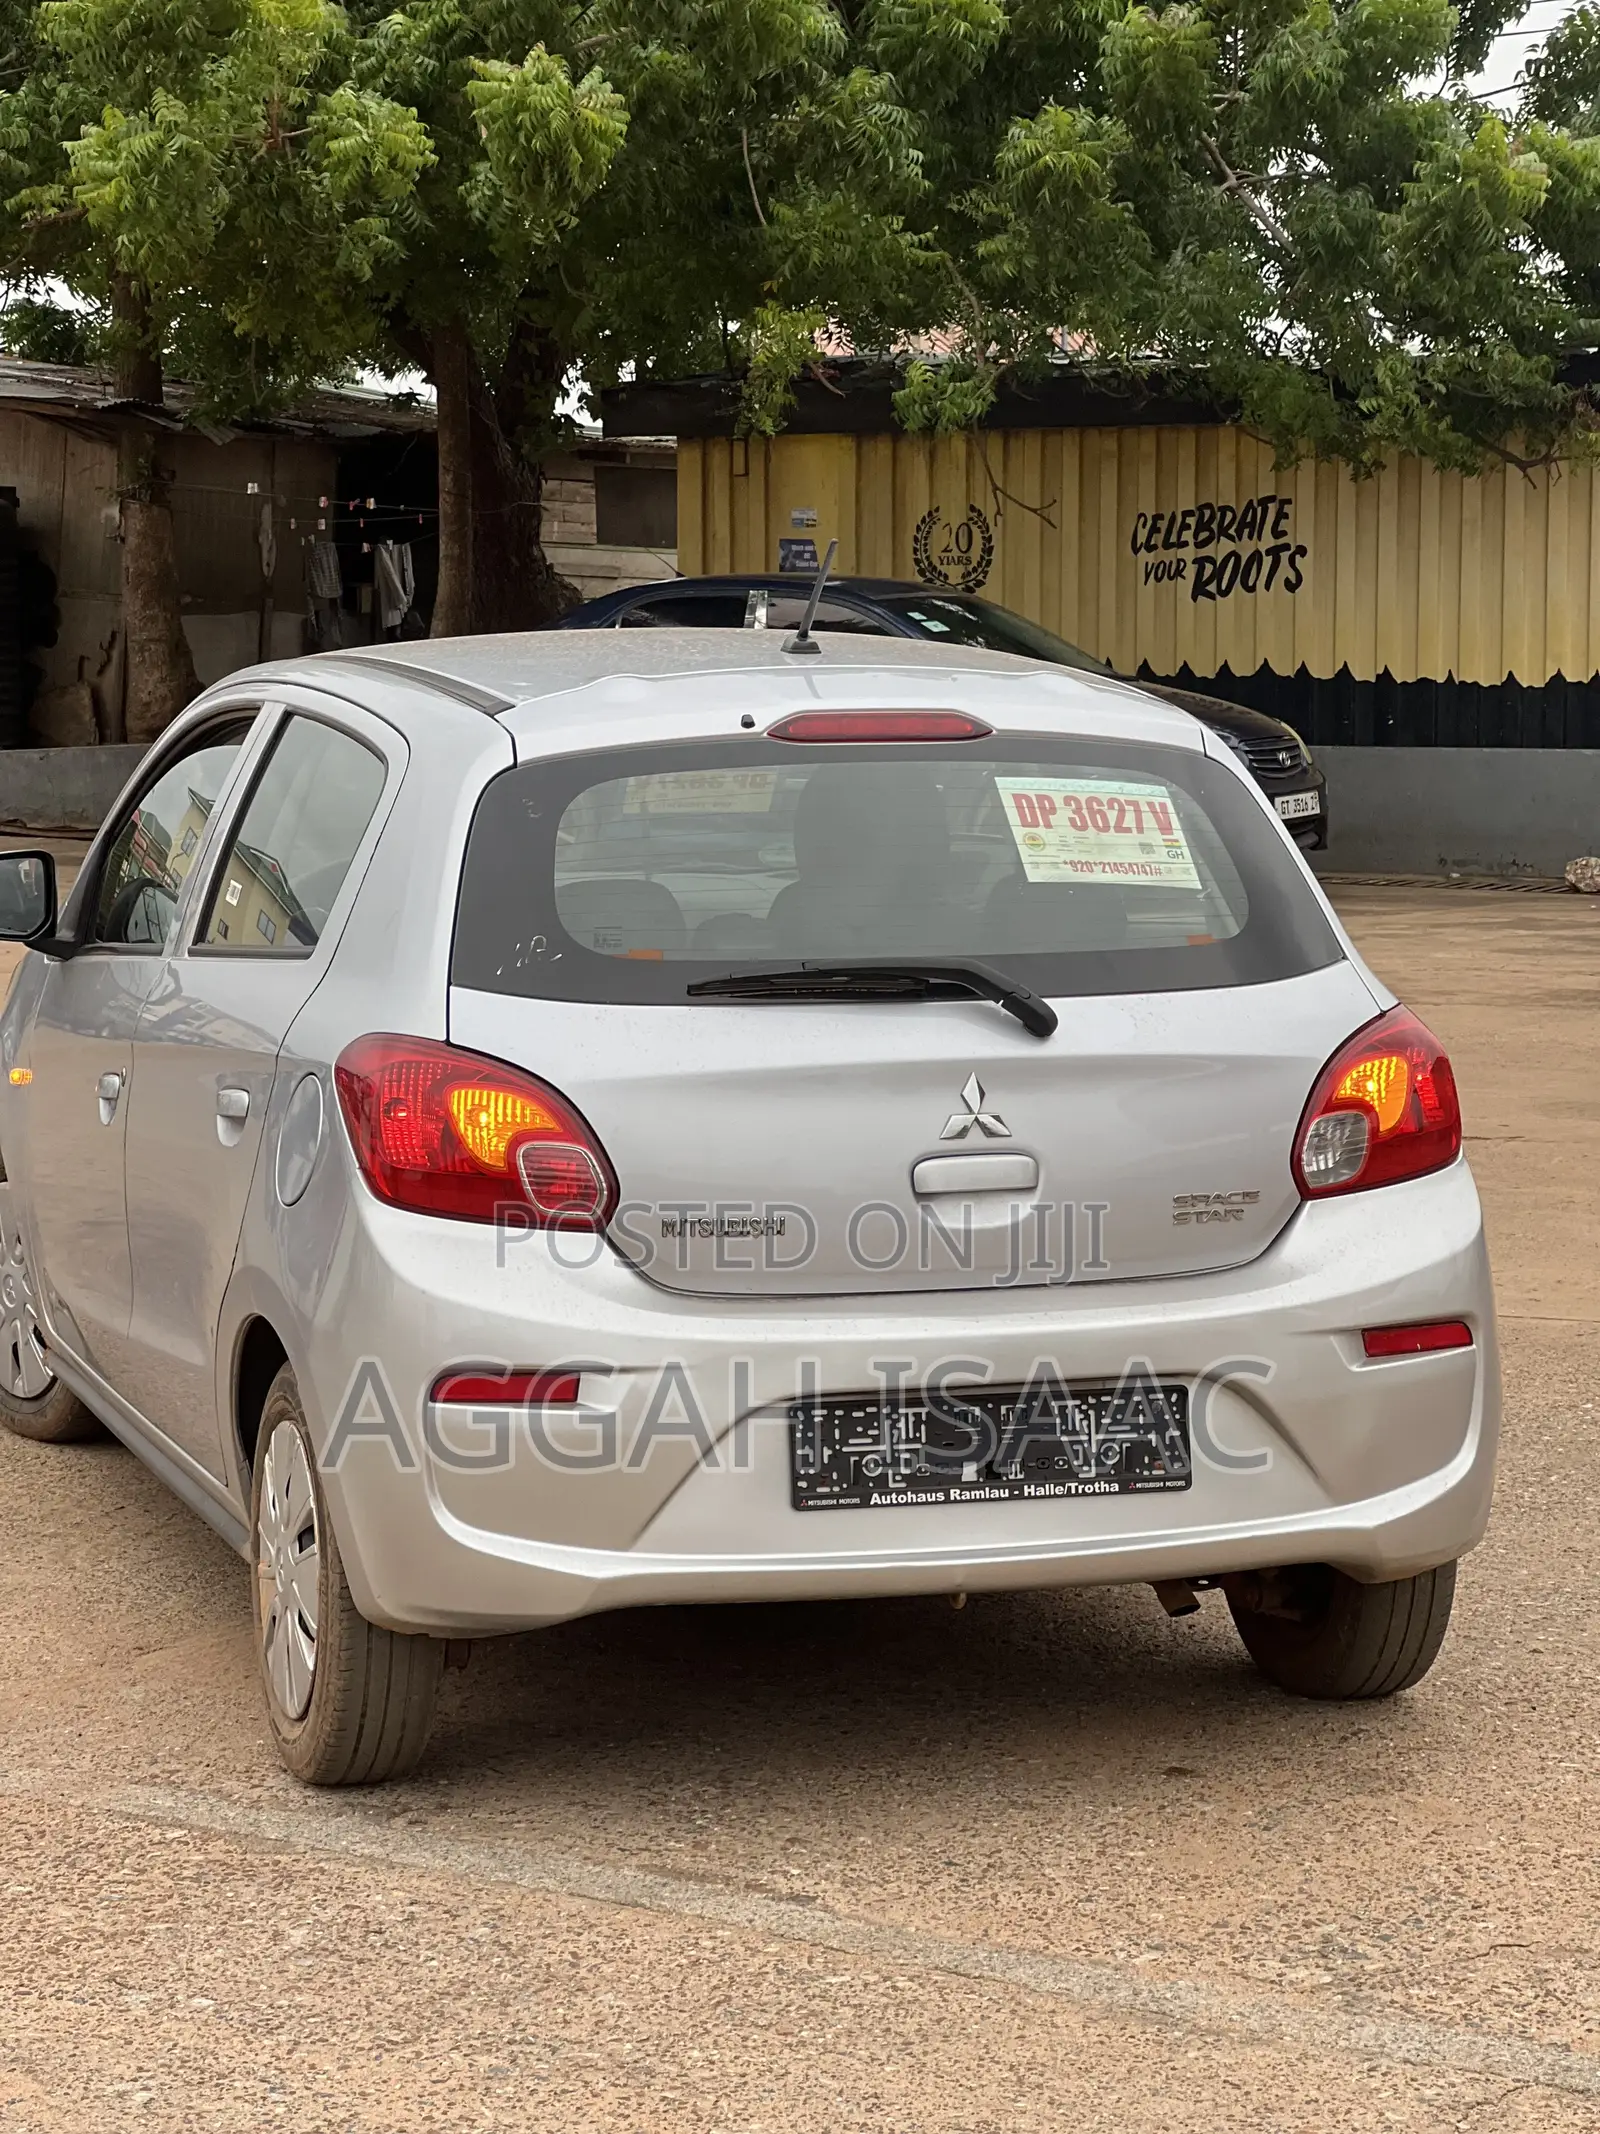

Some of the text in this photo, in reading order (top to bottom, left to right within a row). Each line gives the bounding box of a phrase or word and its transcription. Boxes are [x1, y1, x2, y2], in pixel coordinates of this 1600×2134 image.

[1131, 495, 1292, 556] CELEBRATE
[941, 522, 973, 554] 20
[1144, 543, 1308, 603] YOUR ROOTS
[1011, 793, 1175, 836] DP 3627 V
[1281, 801, 1289, 815] GT
[1167, 850, 1185, 860] GH
[1173, 1189, 1261, 1208] SPACE
[1173, 1207, 1244, 1226] STAR
[661, 1216, 786, 1238] MITSUBISHI
[1165, 1479, 1186, 1487] MOTORS
[838, 1497, 861, 1505] MOTORS
[869, 1490, 945, 1506] Autohaus
[949, 1486, 1009, 1500] Ramlau
[1023, 1481, 1120, 1497] Halle/Trotha
